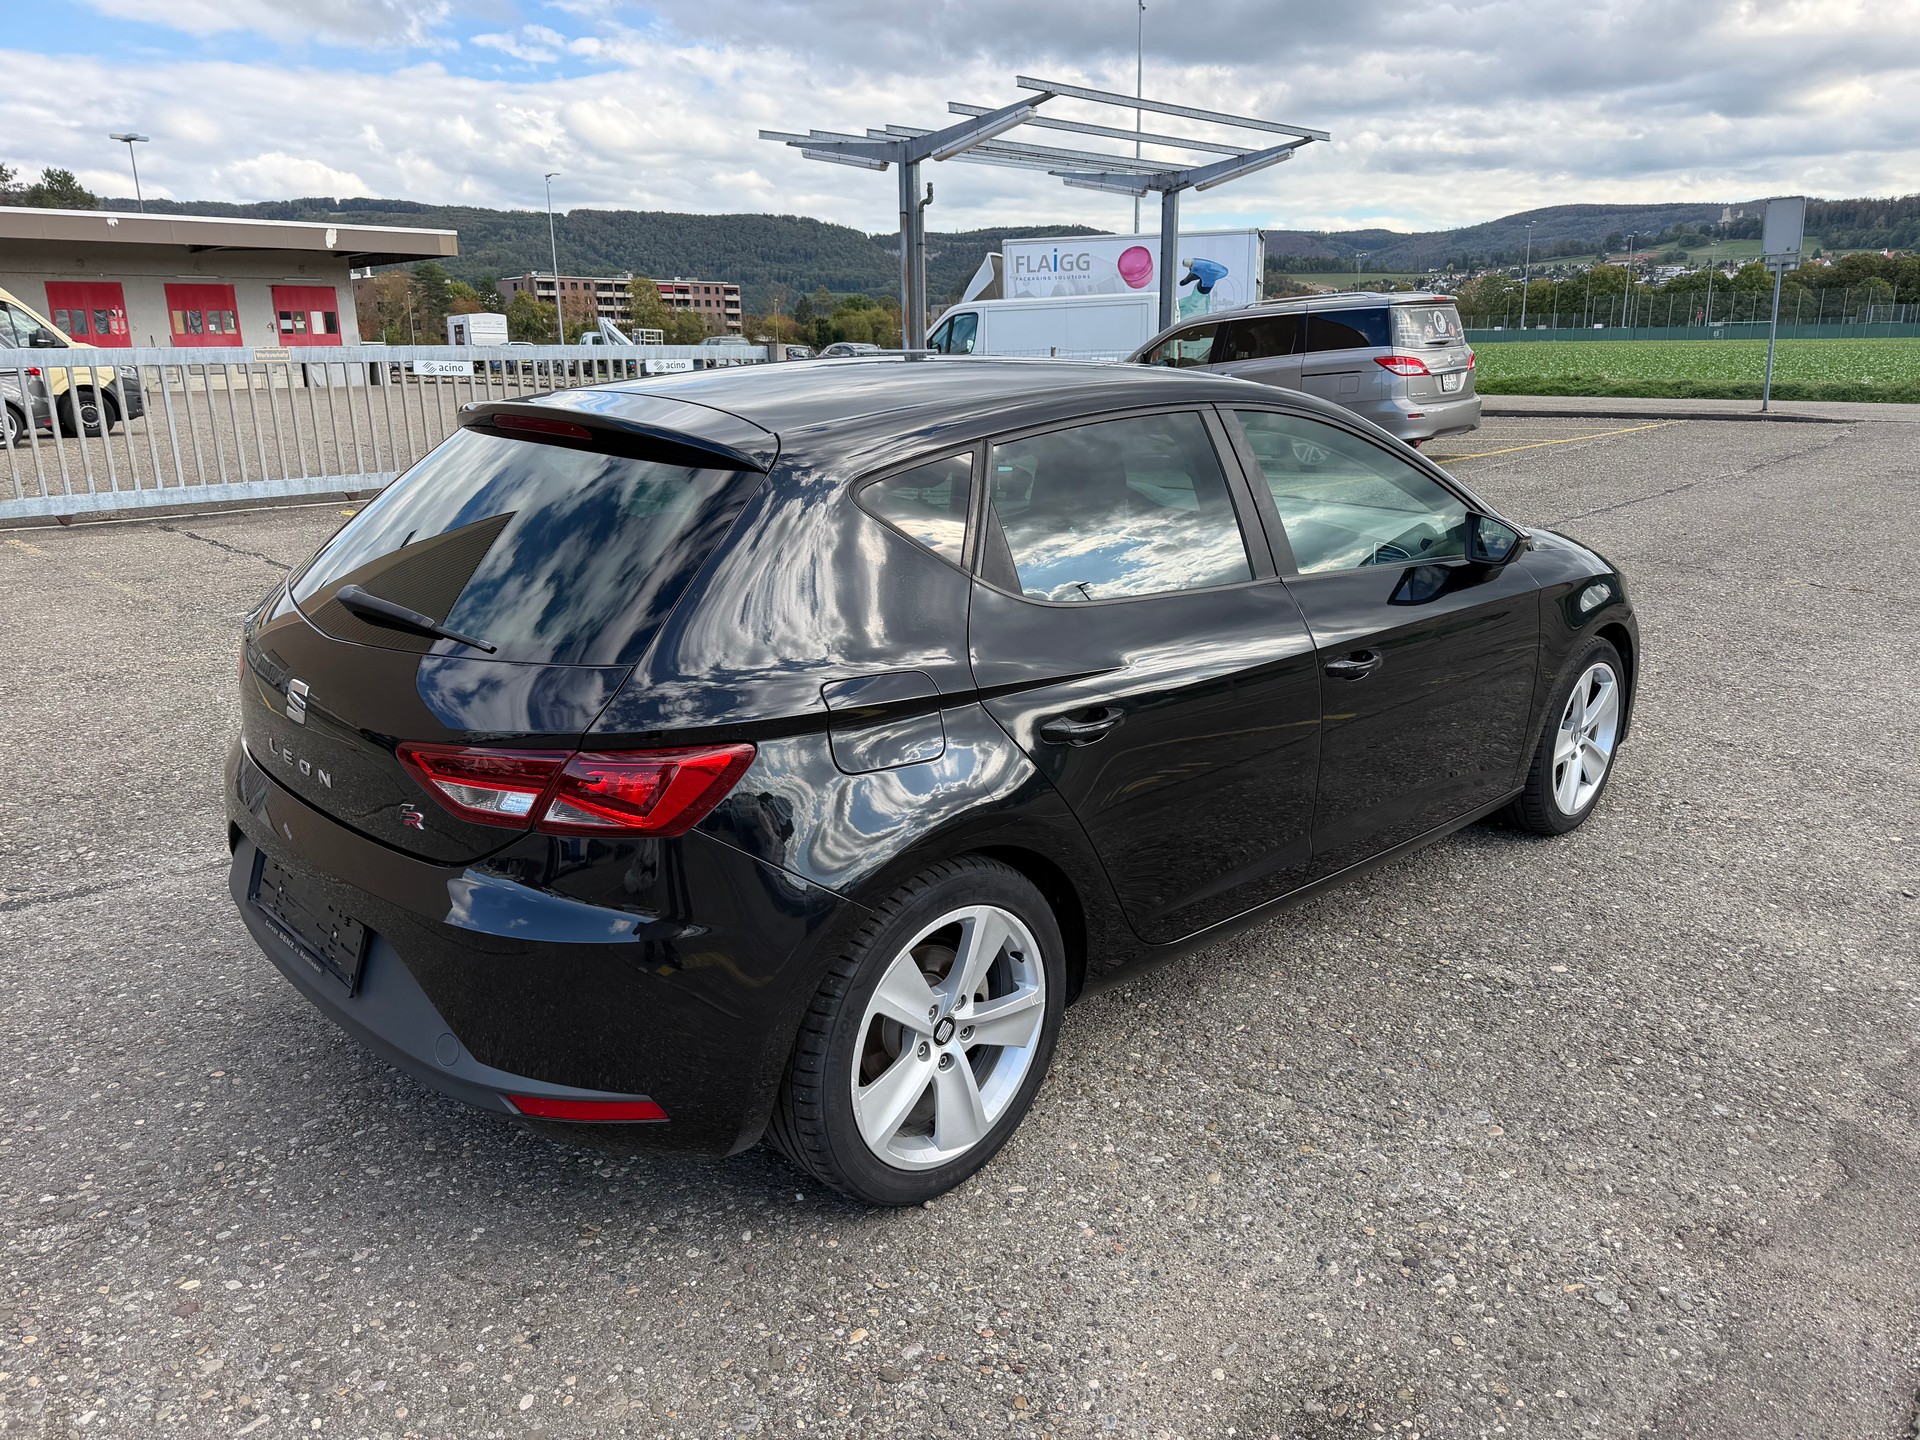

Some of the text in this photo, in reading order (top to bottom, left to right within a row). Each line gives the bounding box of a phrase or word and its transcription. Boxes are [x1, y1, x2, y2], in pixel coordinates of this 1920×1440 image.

[438, 363, 464, 372] acino
[665, 361, 686, 369] acino
[269, 737, 332, 789] LEON
[396, 803, 425, 830] FR
[279, 932, 295, 949] BENZ
